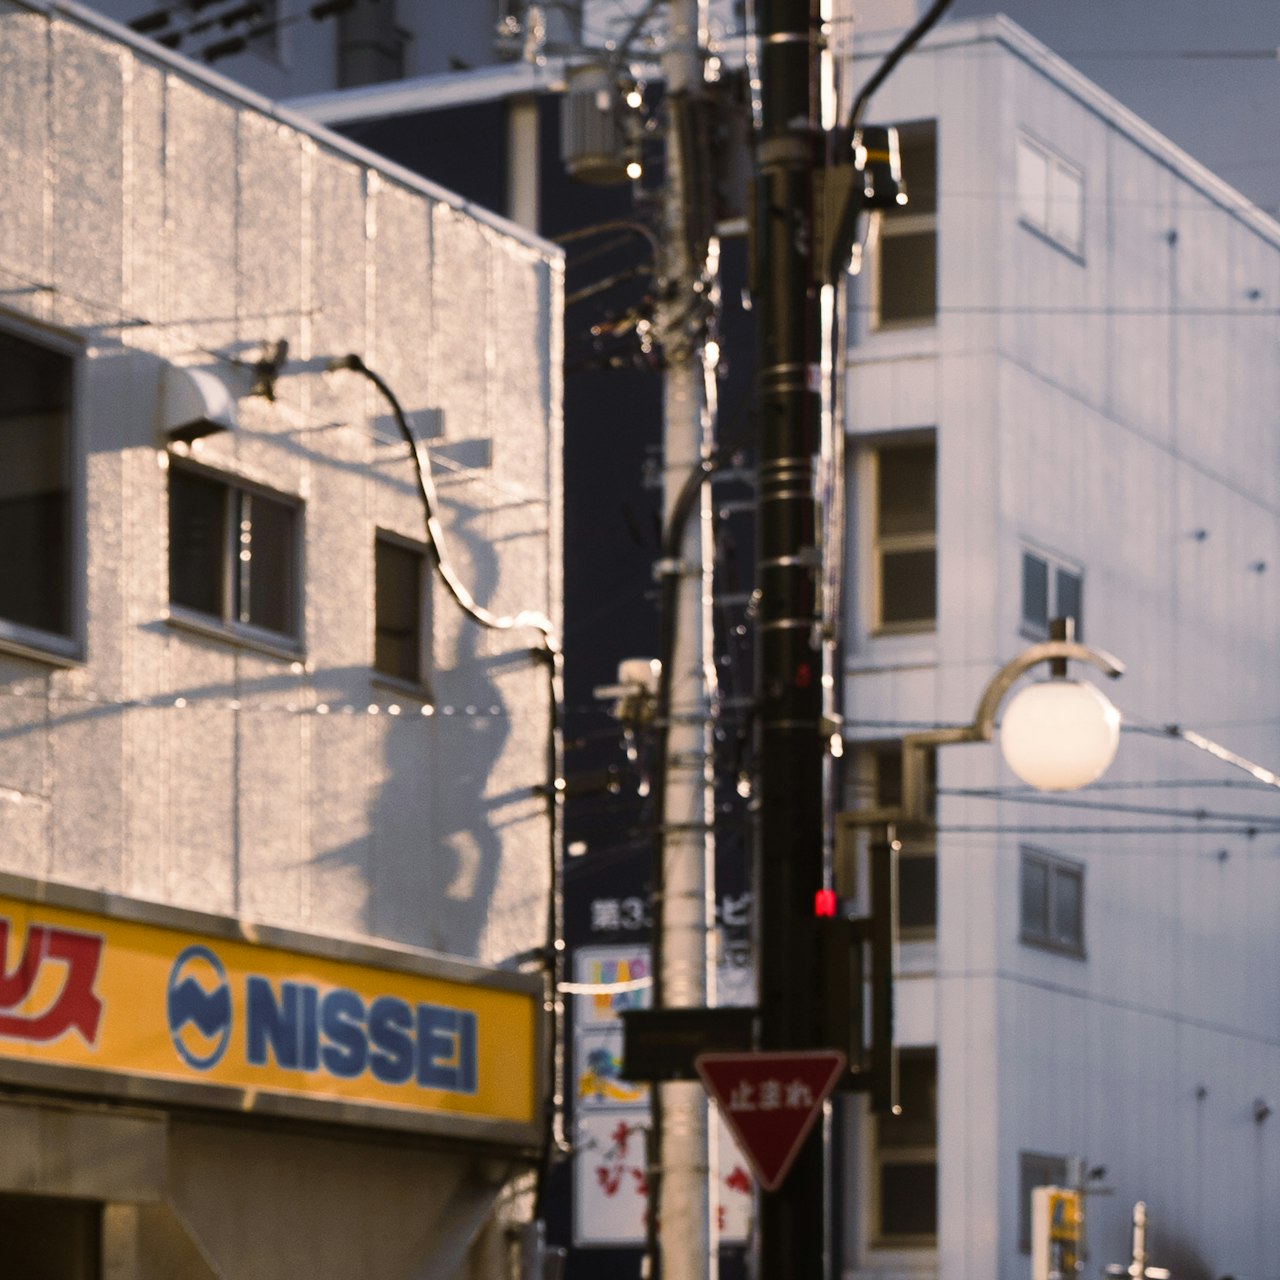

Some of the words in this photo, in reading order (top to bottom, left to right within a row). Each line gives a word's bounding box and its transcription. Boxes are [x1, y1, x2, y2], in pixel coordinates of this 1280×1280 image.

[245, 973, 478, 1095] NISSEI
[727, 1078, 814, 1112] 止まれ
